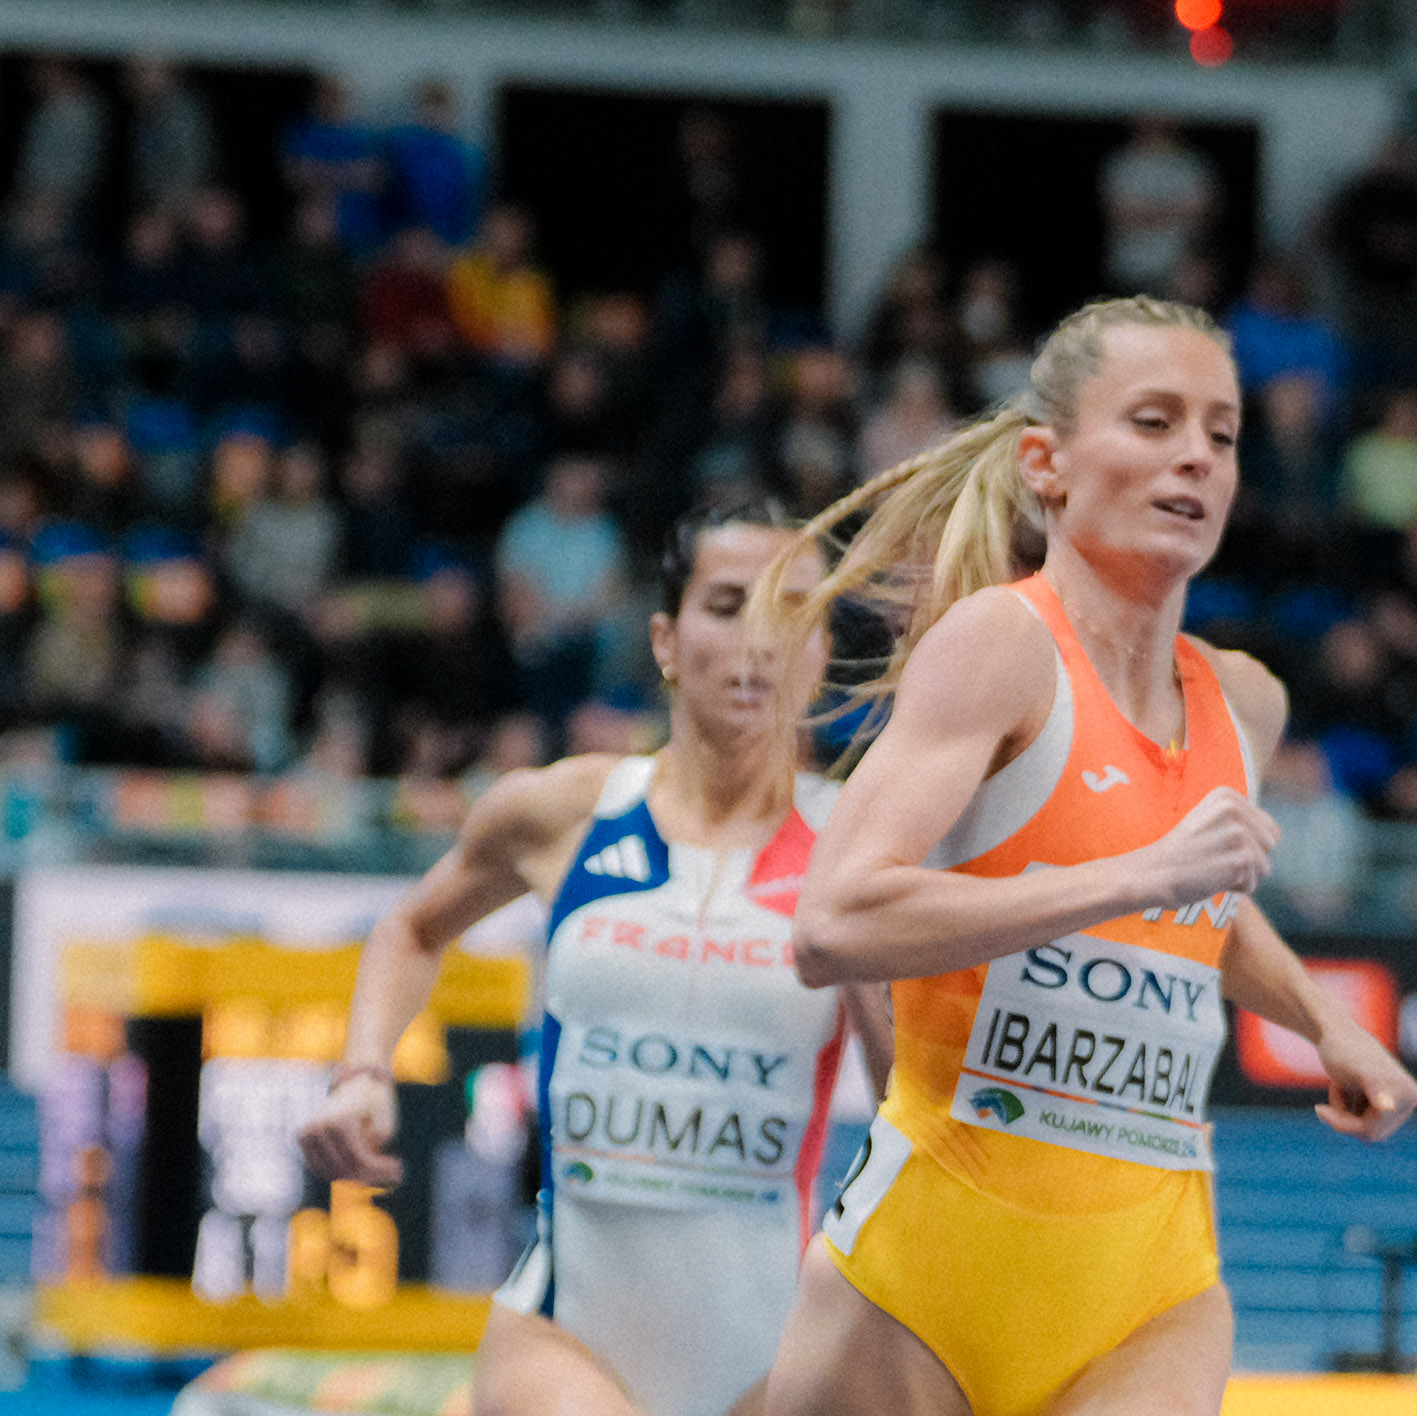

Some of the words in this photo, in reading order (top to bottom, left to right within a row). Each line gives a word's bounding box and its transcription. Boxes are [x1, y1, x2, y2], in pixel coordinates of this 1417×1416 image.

[1021, 944, 1207, 1022] SONY
[578, 1026, 790, 1088] SONY
[980, 1008, 1196, 1114] IBARZABAL
[565, 1092, 789, 1165] DUMAS
